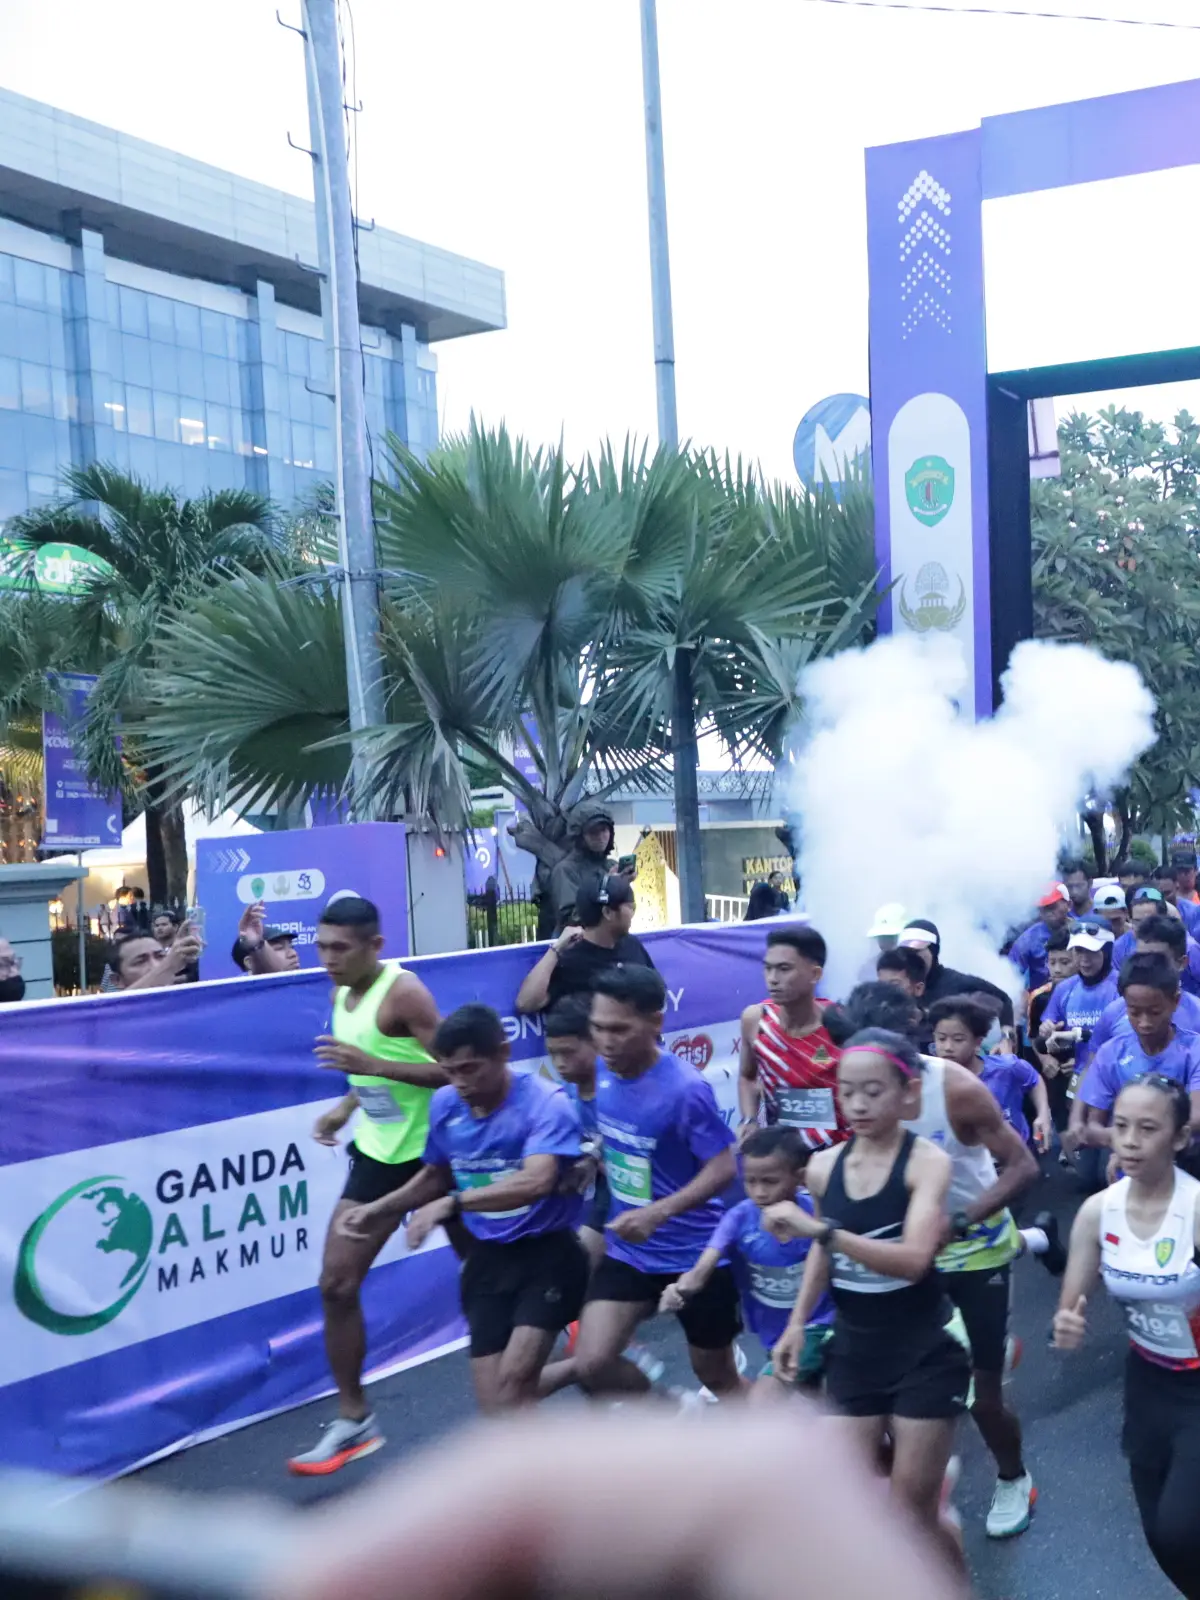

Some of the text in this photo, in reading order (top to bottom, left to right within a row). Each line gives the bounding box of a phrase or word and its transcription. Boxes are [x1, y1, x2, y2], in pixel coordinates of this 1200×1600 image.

[780, 1098, 828, 1114] 3255
[156, 1142, 306, 1204] GANDA
[158, 1180, 308, 1254] ALAM
[158, 1228, 308, 1292] MAKMUR
[1126, 1306, 1183, 1338] 2194
